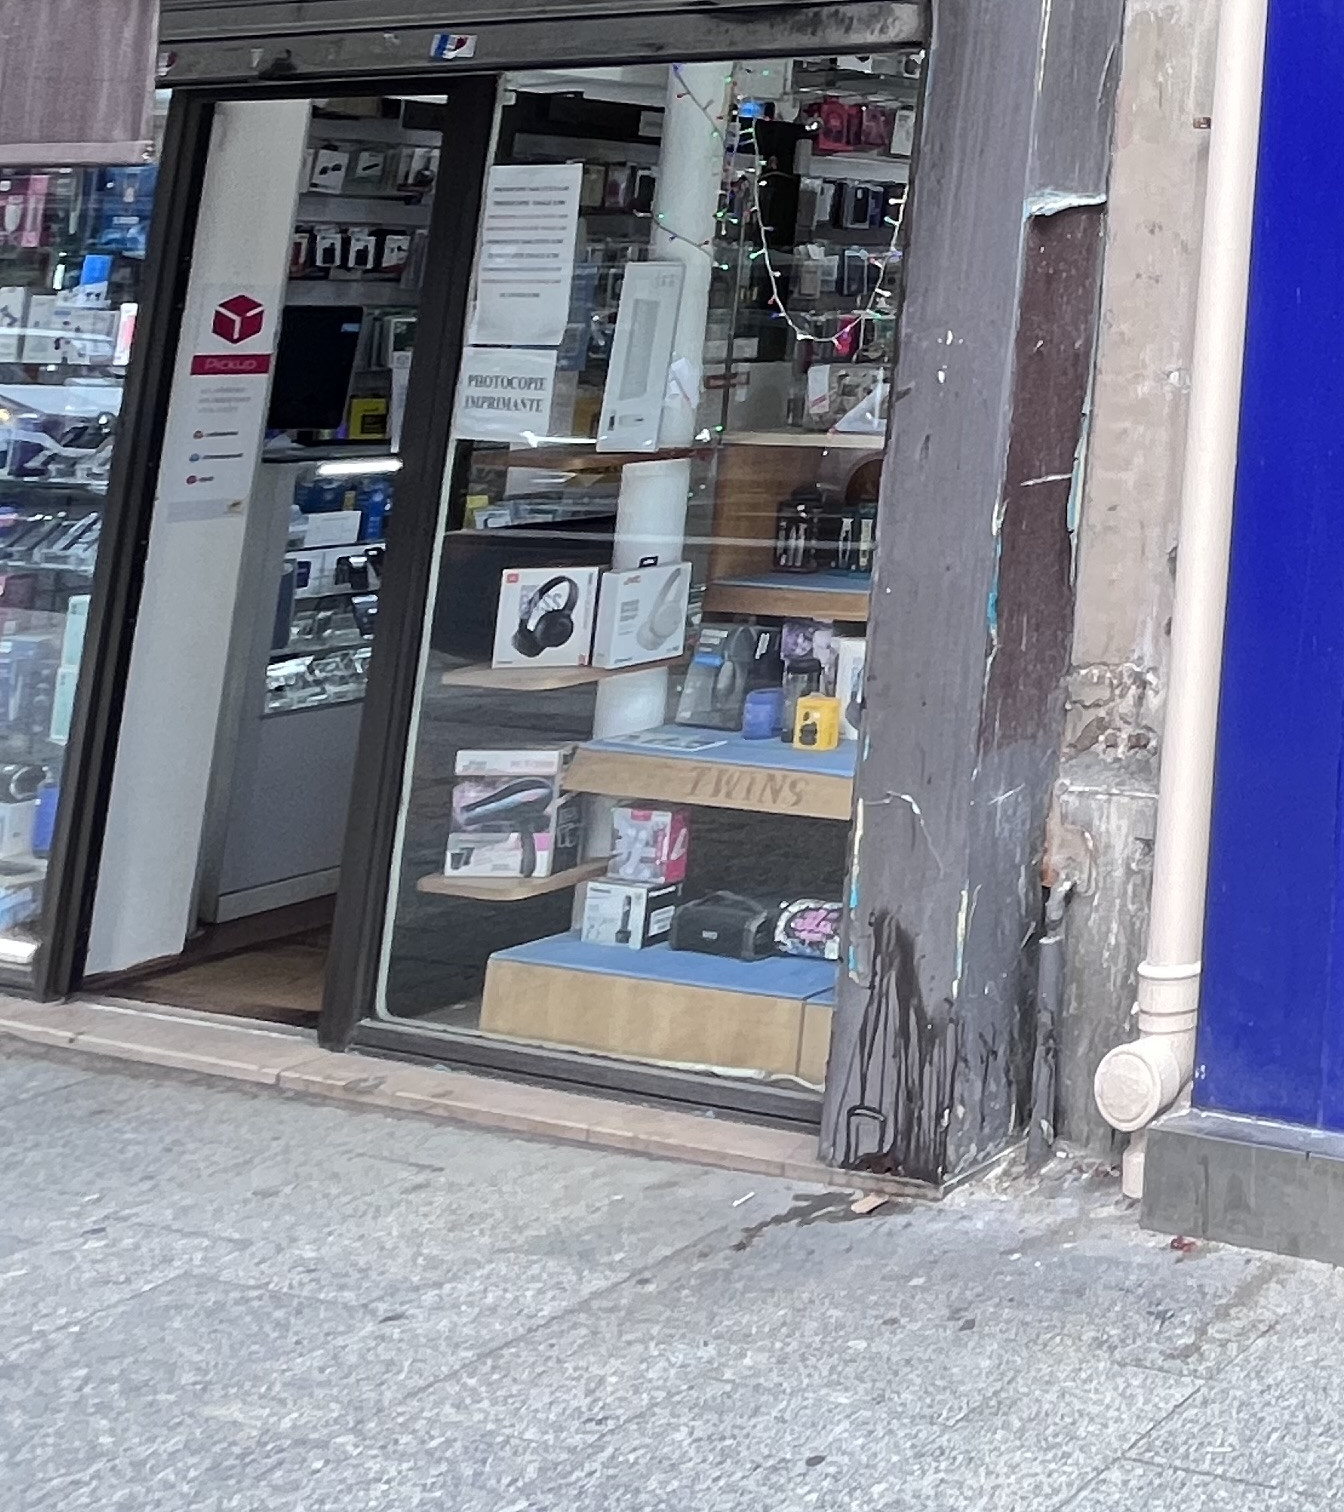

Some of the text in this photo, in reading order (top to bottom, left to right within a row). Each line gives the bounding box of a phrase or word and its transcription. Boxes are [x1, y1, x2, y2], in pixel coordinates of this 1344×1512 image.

[467, 374, 548, 392] PHOTOCOPIE
[463, 395, 545, 414] IMPRIMANTE
[686, 766, 810, 808] TWINS
